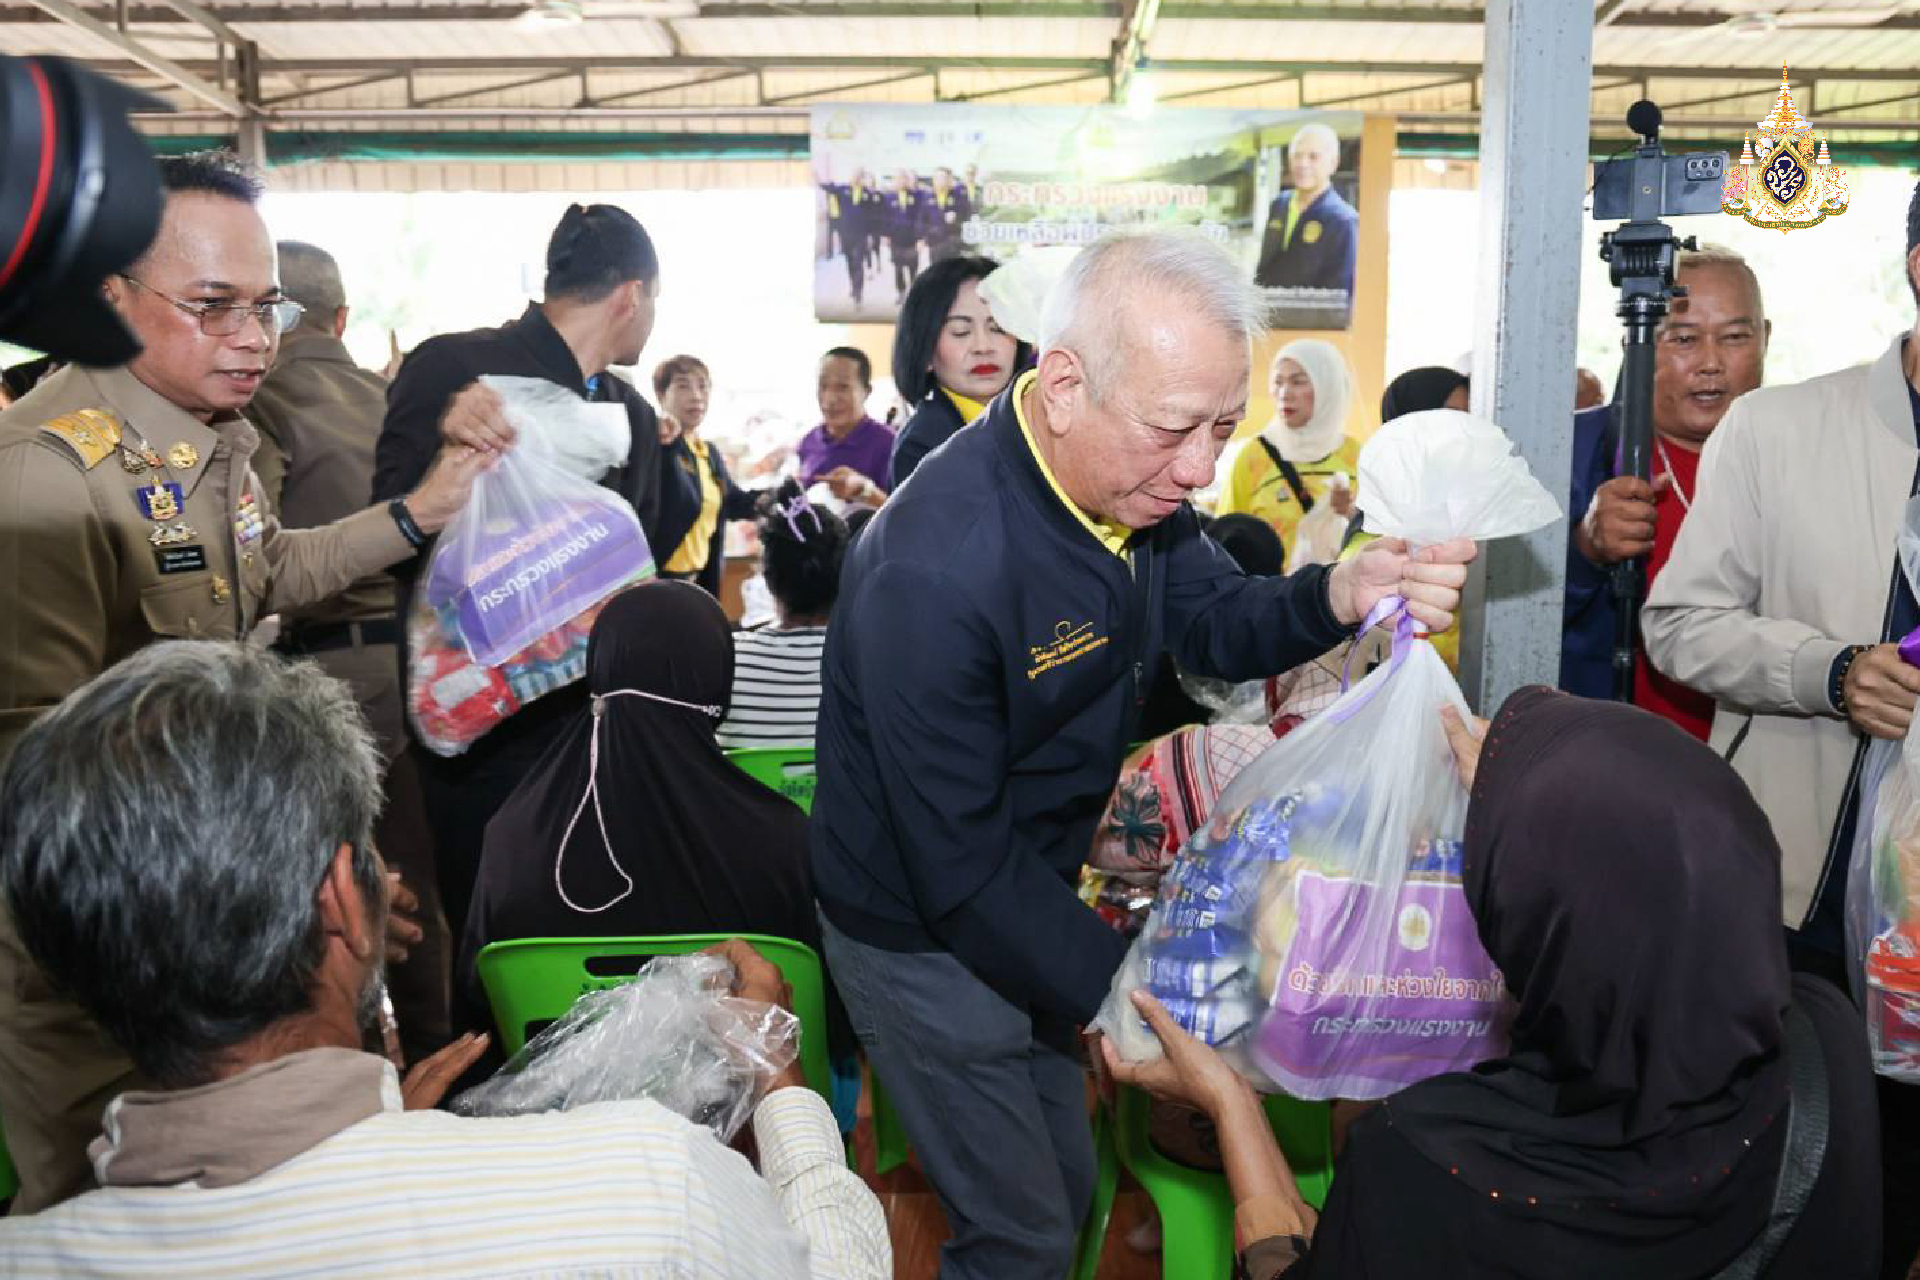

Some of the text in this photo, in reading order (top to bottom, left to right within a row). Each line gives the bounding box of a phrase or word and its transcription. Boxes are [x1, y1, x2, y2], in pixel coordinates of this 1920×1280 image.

[983, 180, 1209, 206] กระทรวงแรงงาน
[479, 522, 610, 613] กระทรวงแรงงาน
[1311, 1016, 1491, 1038] กระทรวงแรงงาน
